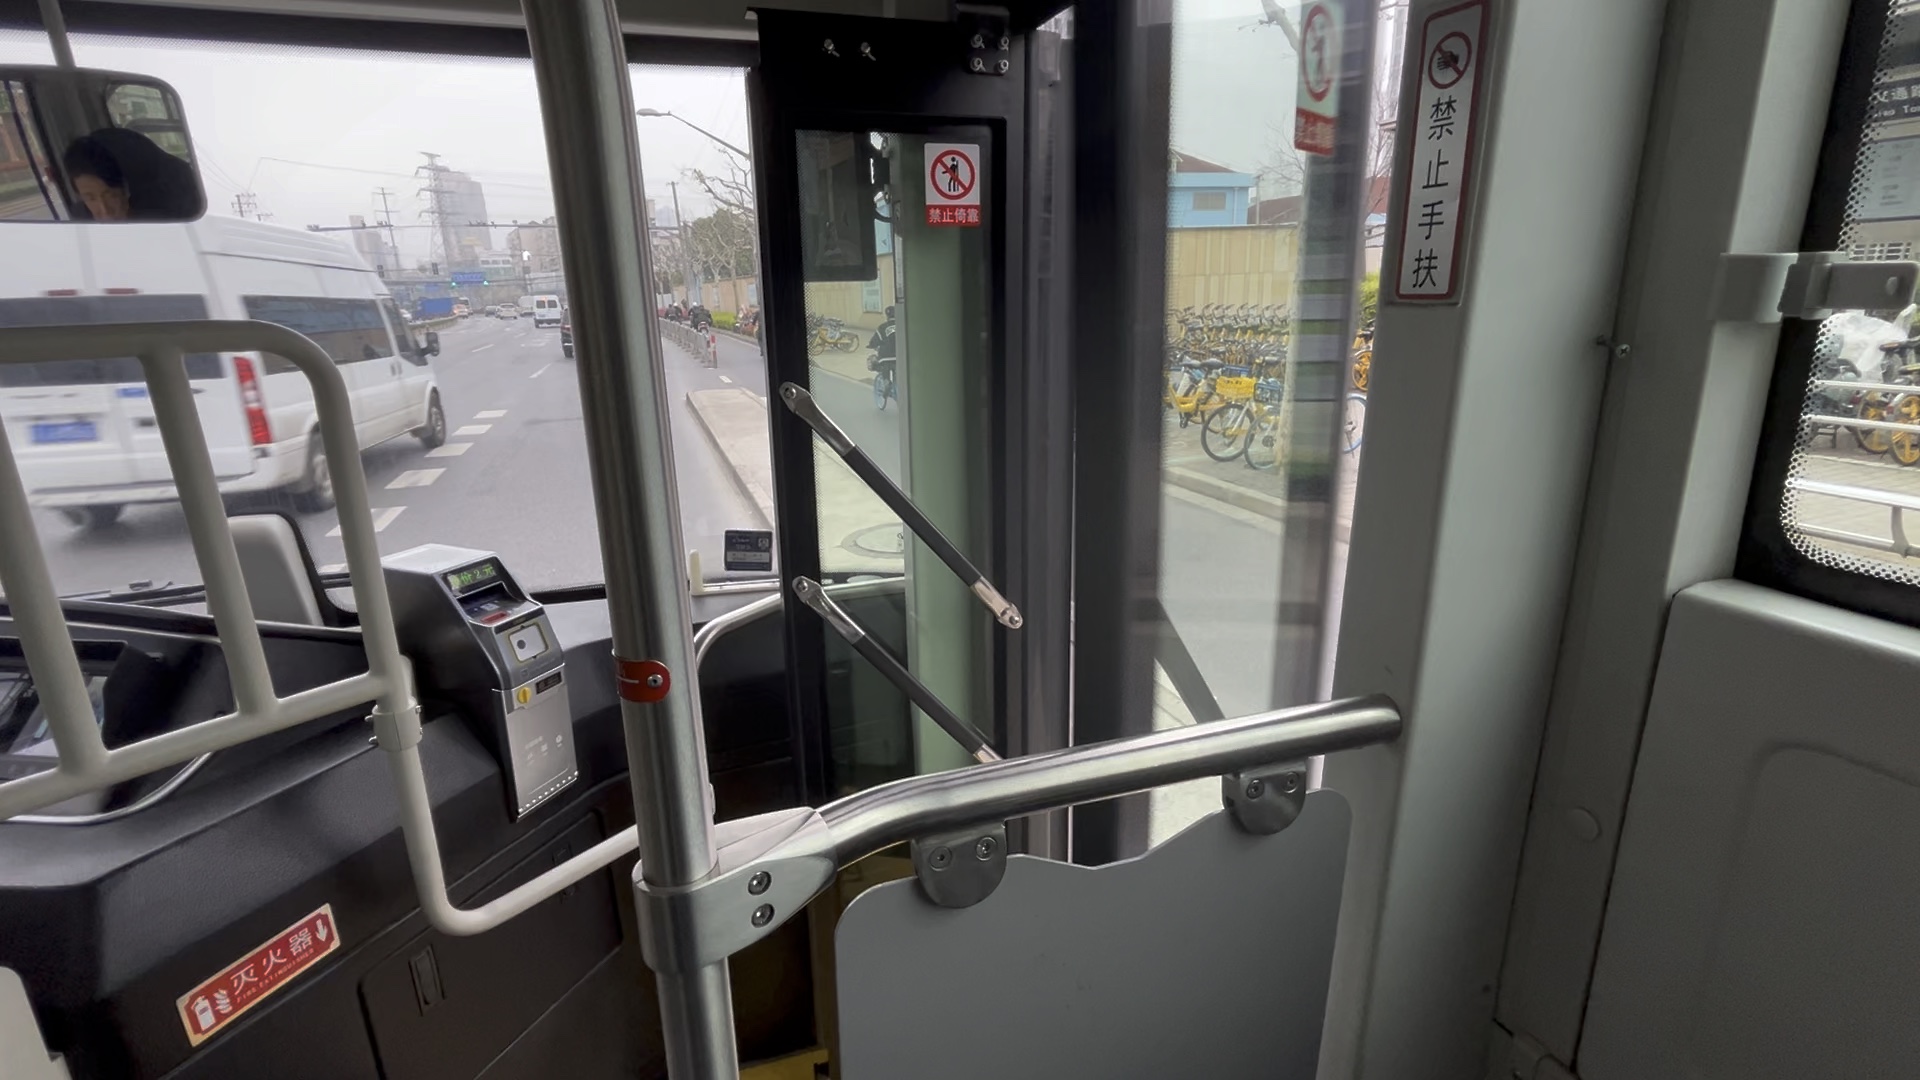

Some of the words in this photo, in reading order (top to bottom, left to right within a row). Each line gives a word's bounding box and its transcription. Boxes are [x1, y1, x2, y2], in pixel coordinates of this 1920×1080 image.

[1412, 96, 1457, 289] 禁止手扶
[929, 208, 979, 223] 禁止倚靠
[230, 927, 312, 995] 灭火器
[236, 987, 256, 1003] FIRE
